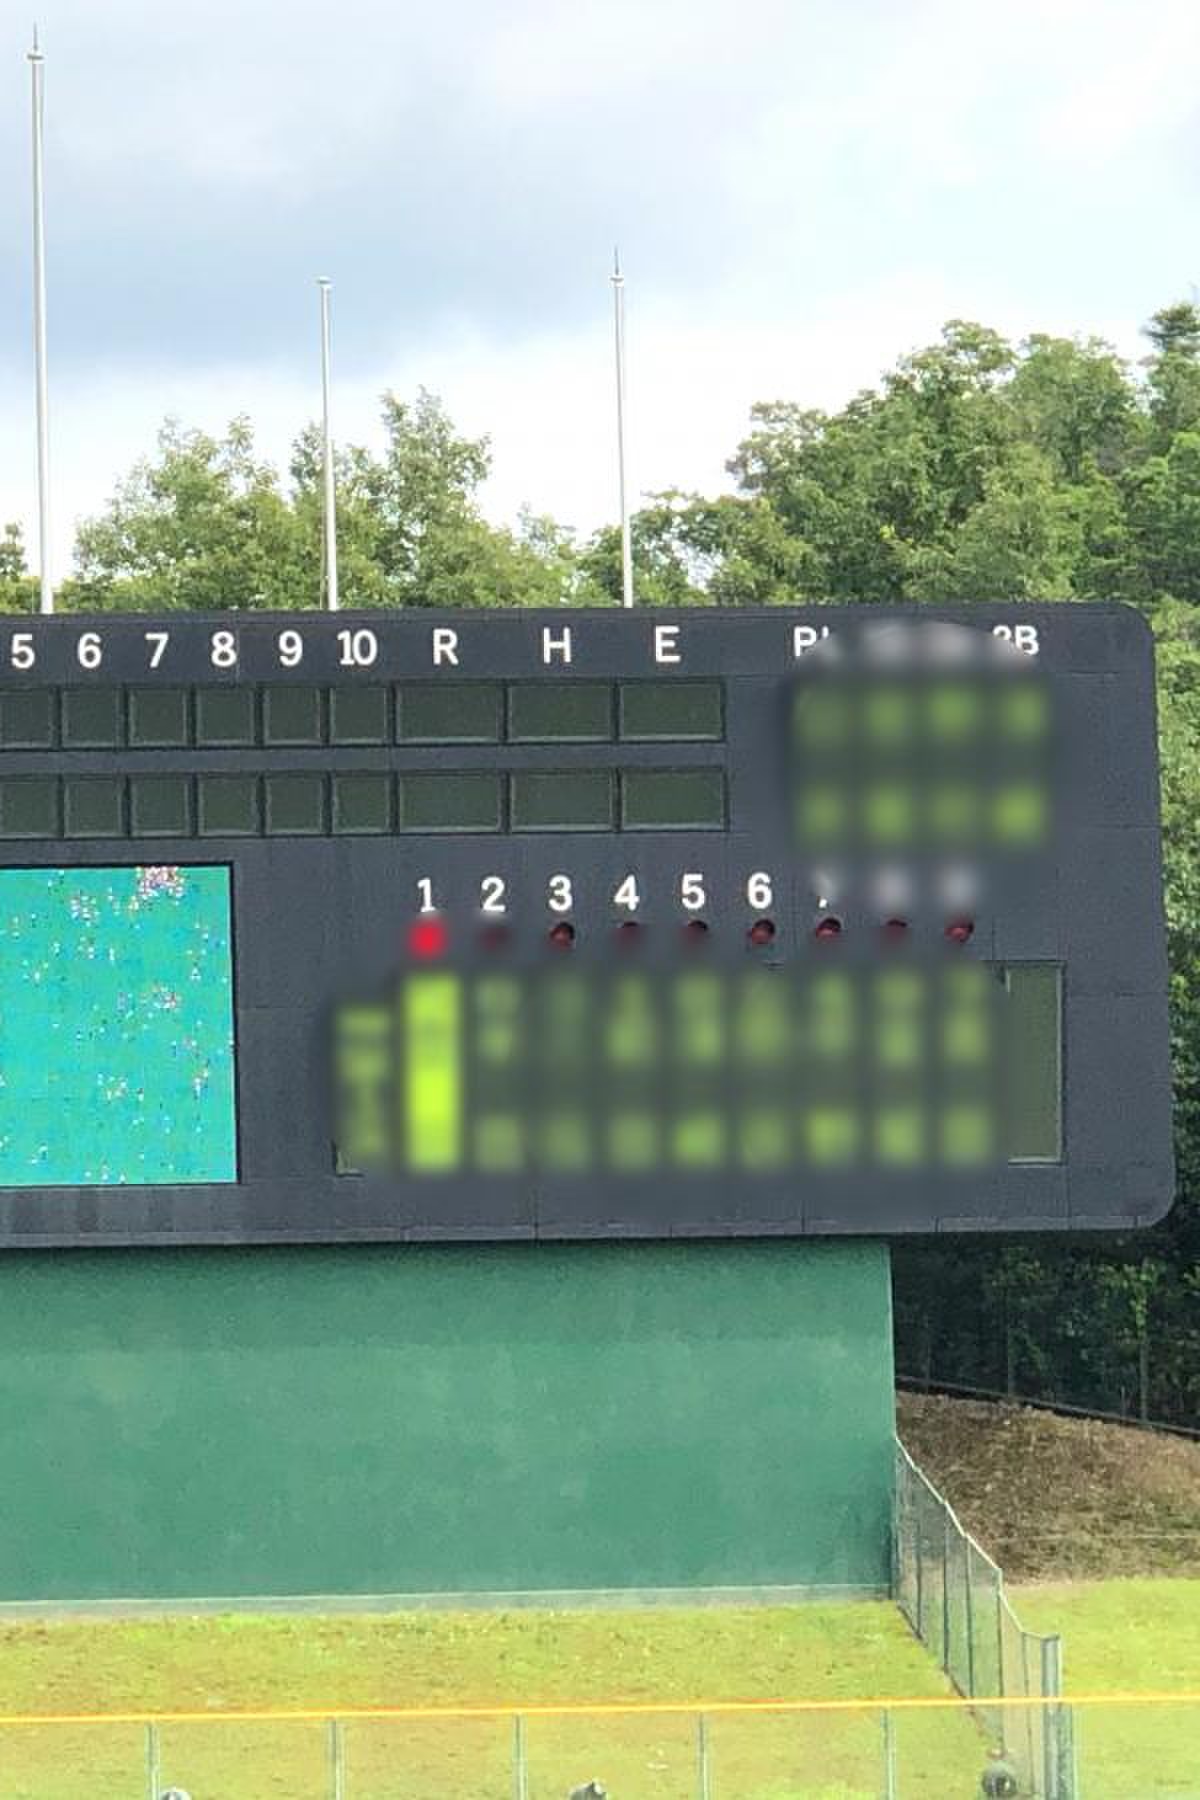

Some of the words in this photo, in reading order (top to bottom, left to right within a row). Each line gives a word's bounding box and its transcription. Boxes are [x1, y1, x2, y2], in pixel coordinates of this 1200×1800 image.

[11, 633, 36, 669] 5
[77, 632, 102, 669] 6
[145, 632, 169, 668] 7
[211, 630, 238, 668] 8
[278, 630, 303, 667] 9
[337, 629, 378, 666] 10
[432, 628, 459, 665] R
[543, 626, 572, 664] H
[654, 625, 681, 663] E
[417, 877, 437, 915] 1
[481, 876, 506, 914] 2
[548, 874, 573, 913] 3
[613, 874, 641, 911] 4
[681, 873, 706, 911] 5
[747, 871, 773, 910] 6
